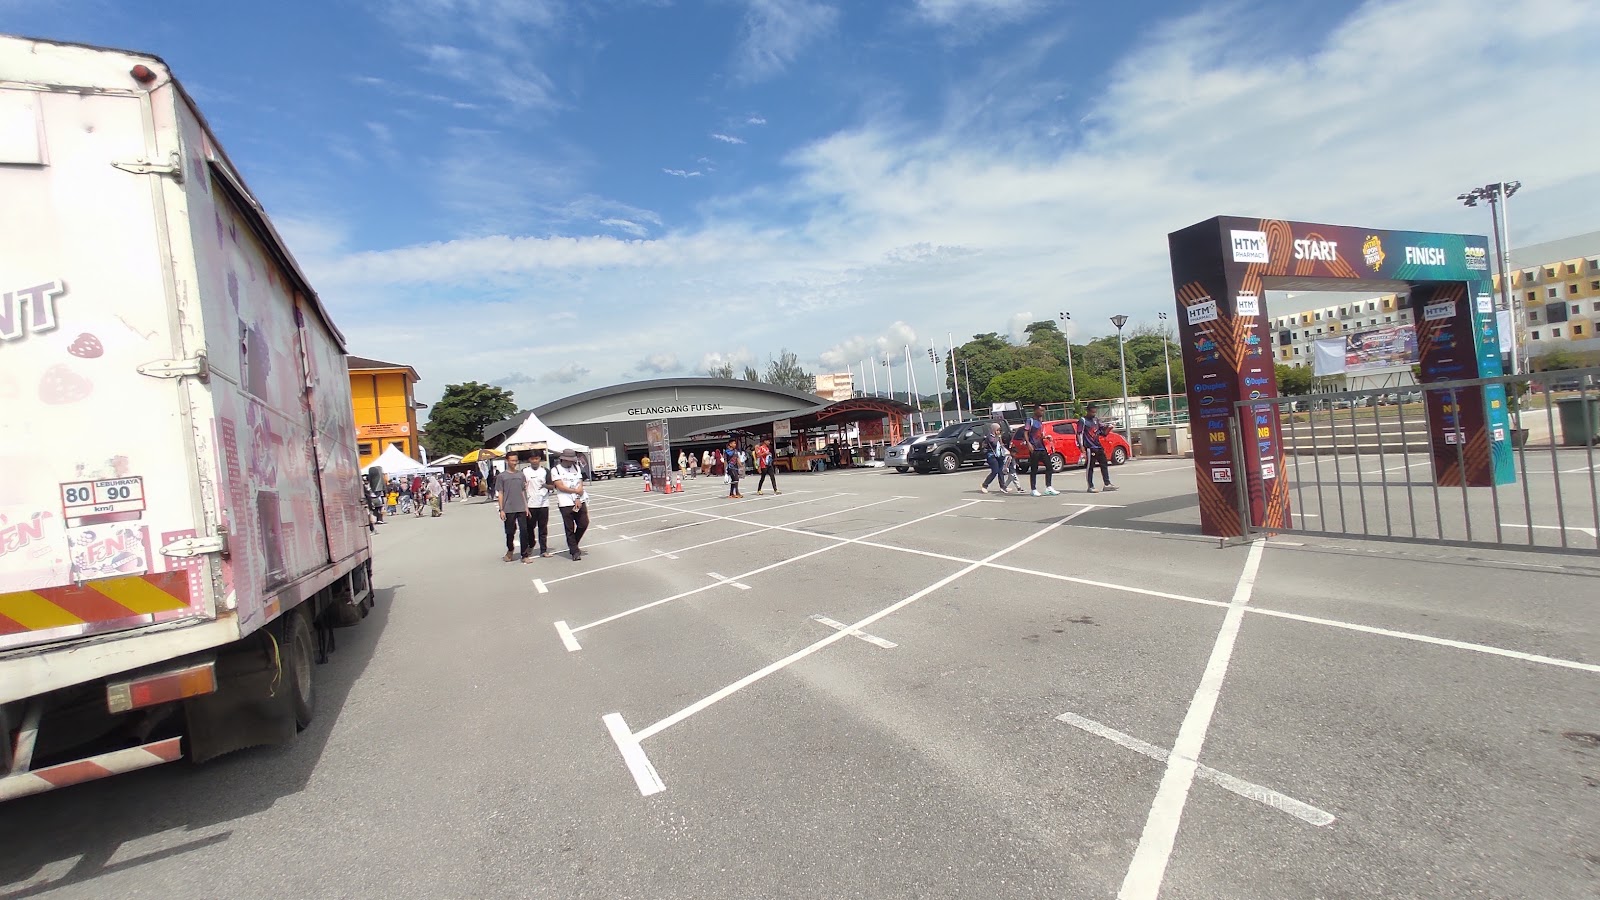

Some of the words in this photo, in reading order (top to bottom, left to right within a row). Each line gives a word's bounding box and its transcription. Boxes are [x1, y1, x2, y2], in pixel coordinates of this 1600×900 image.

[1234, 238, 1260, 250] HTM
[1293, 239, 1338, 261] START
[1235, 251, 1265, 259] PHARMACY
[1404, 246, 1446, 265] FINISH
[1189, 306, 1210, 317] HTM
[1425, 306, 1449, 316] HTM
[627, 405, 689, 416] GELANGGANG
[690, 403, 723, 412] FUTSAL
[1209, 431, 1226, 442] NB
[1257, 426, 1270, 438] NB
[95, 478, 139, 488] LEBUHRAYA
[65, 486, 90, 503] 80
[107, 485, 131, 500] 90
[94, 504, 114, 512] km/j
